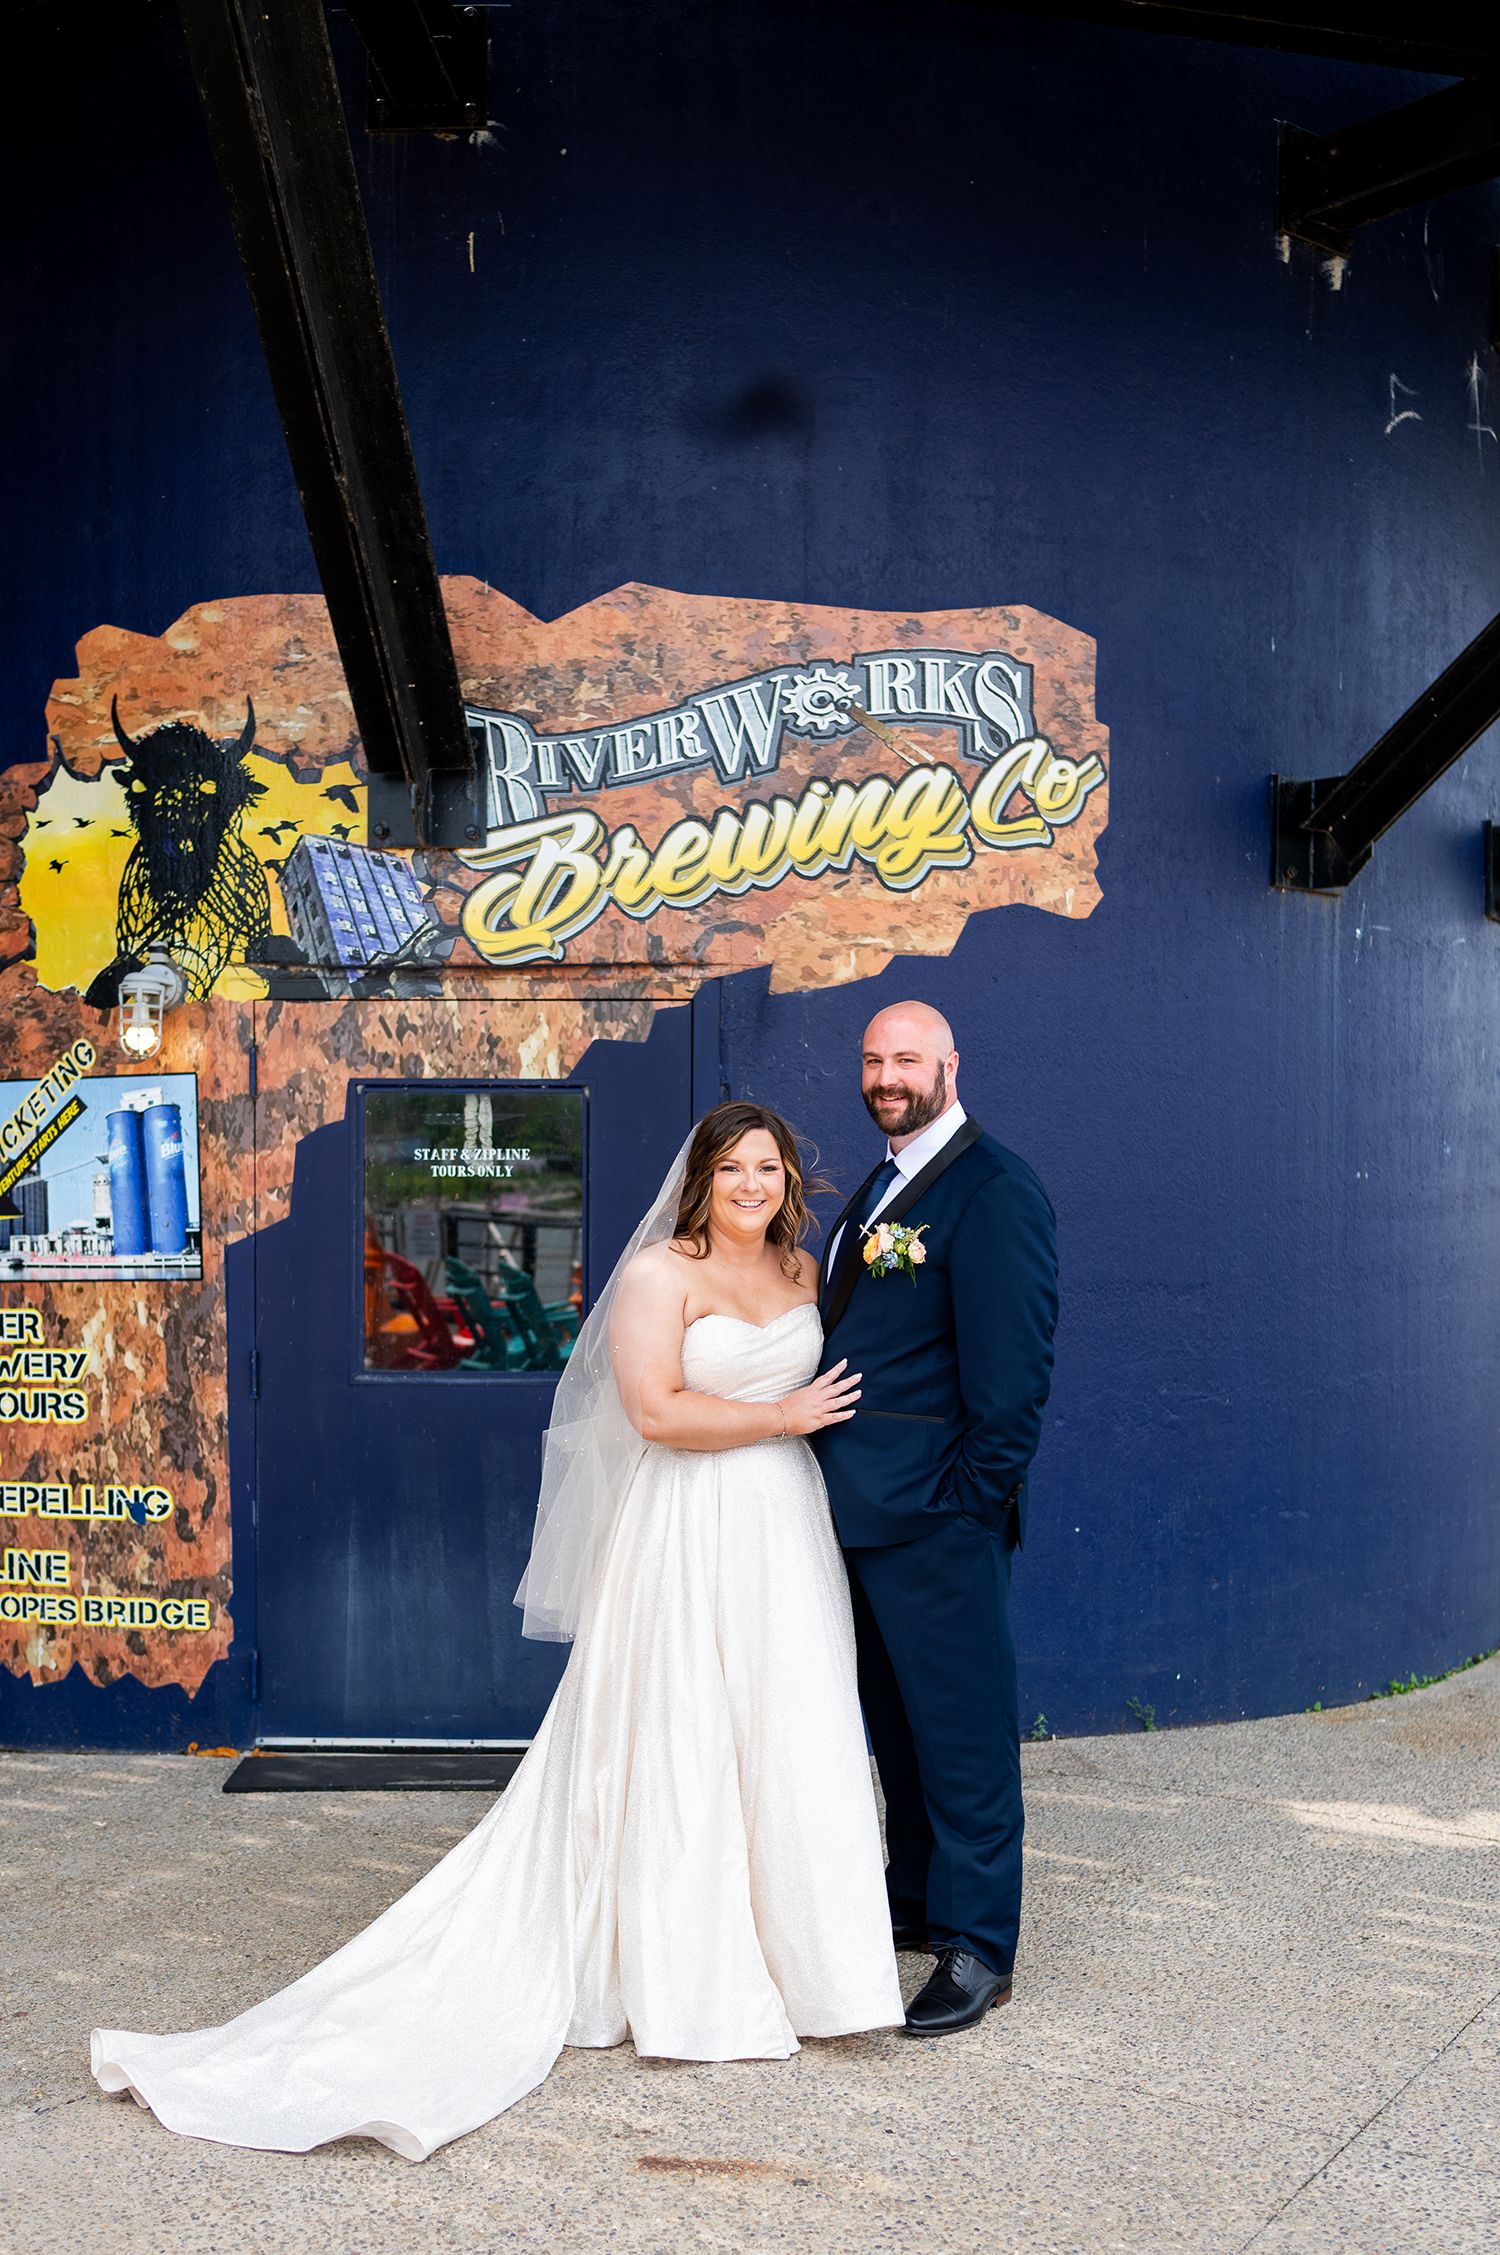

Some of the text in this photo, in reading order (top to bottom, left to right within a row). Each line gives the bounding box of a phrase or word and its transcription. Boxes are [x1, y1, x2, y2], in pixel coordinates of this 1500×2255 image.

[457, 736, 1104, 962] Brewing Co
[29, 1124, 58, 1160] STARTS
[57, 1100, 80, 1130] HERE
[414, 1148, 531, 1161] STAFF & ZIPLINE
[430, 1165, 514, 1178] TOURS ONLY
[0, 1392, 86, 1420] OURS
[0, 1552, 68, 1584] INE
[0, 1595, 208, 1628] OPES BRIDGE
